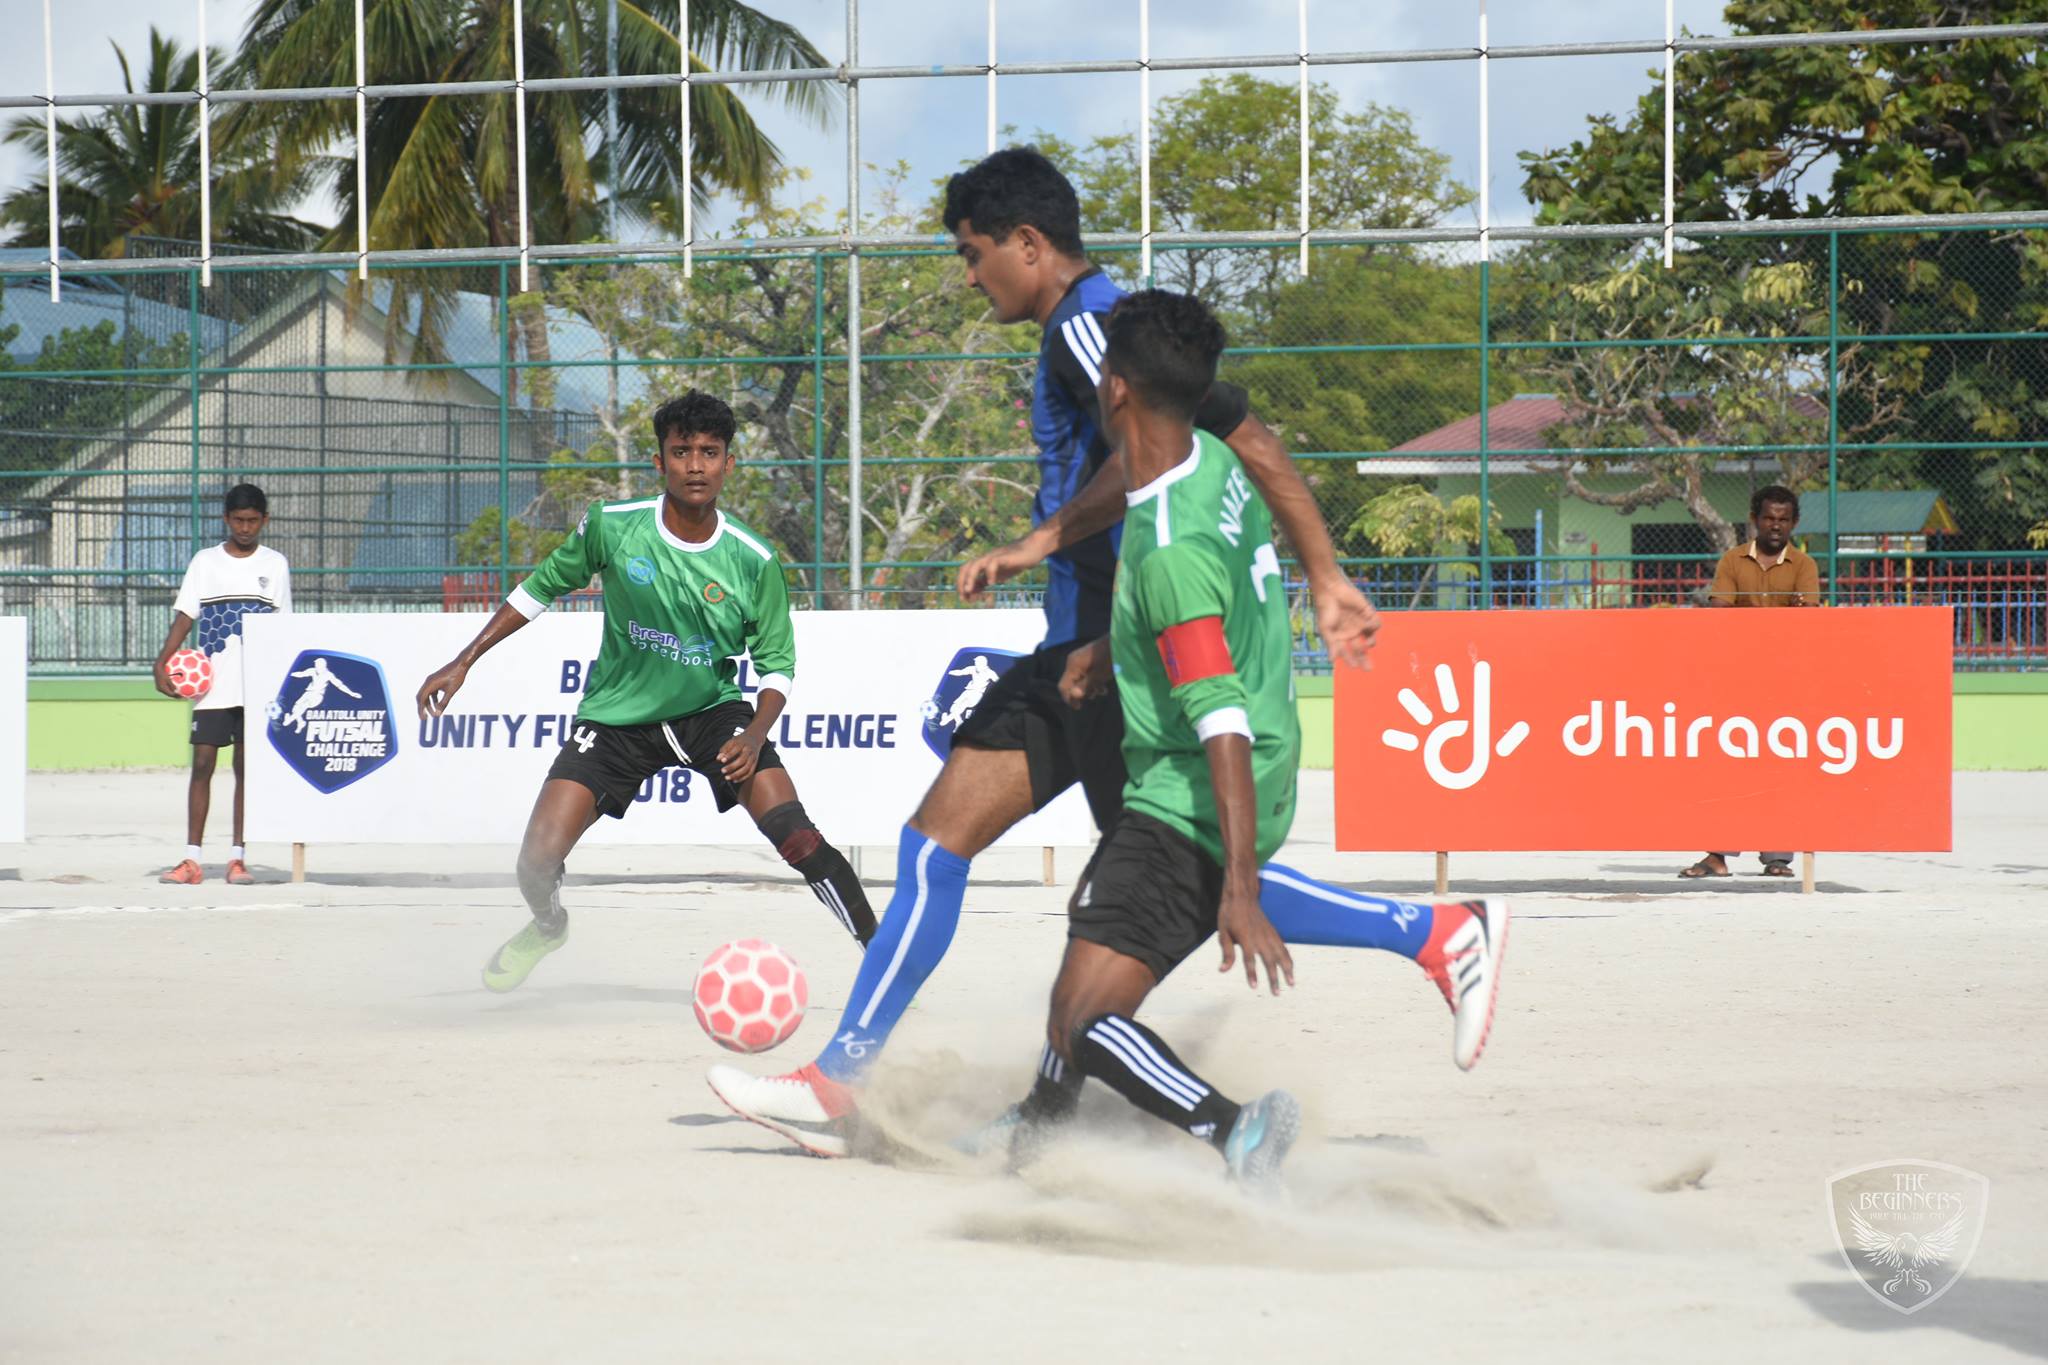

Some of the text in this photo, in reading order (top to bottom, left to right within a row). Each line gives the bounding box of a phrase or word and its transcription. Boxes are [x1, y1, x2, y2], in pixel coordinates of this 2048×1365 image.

[629, 620, 681, 649] Dream
[306, 720, 386, 742] FUTSAL
[419, 714, 527, 748] UNITY
[772, 714, 897, 748] LENGE
[573, 726, 597, 753] 4
[1562, 700, 1904, 775] dhiraagu
[306, 743, 386, 757] CHALLENGE
[324, 758, 357, 772] 2018
[634, 769, 691, 803] 018
